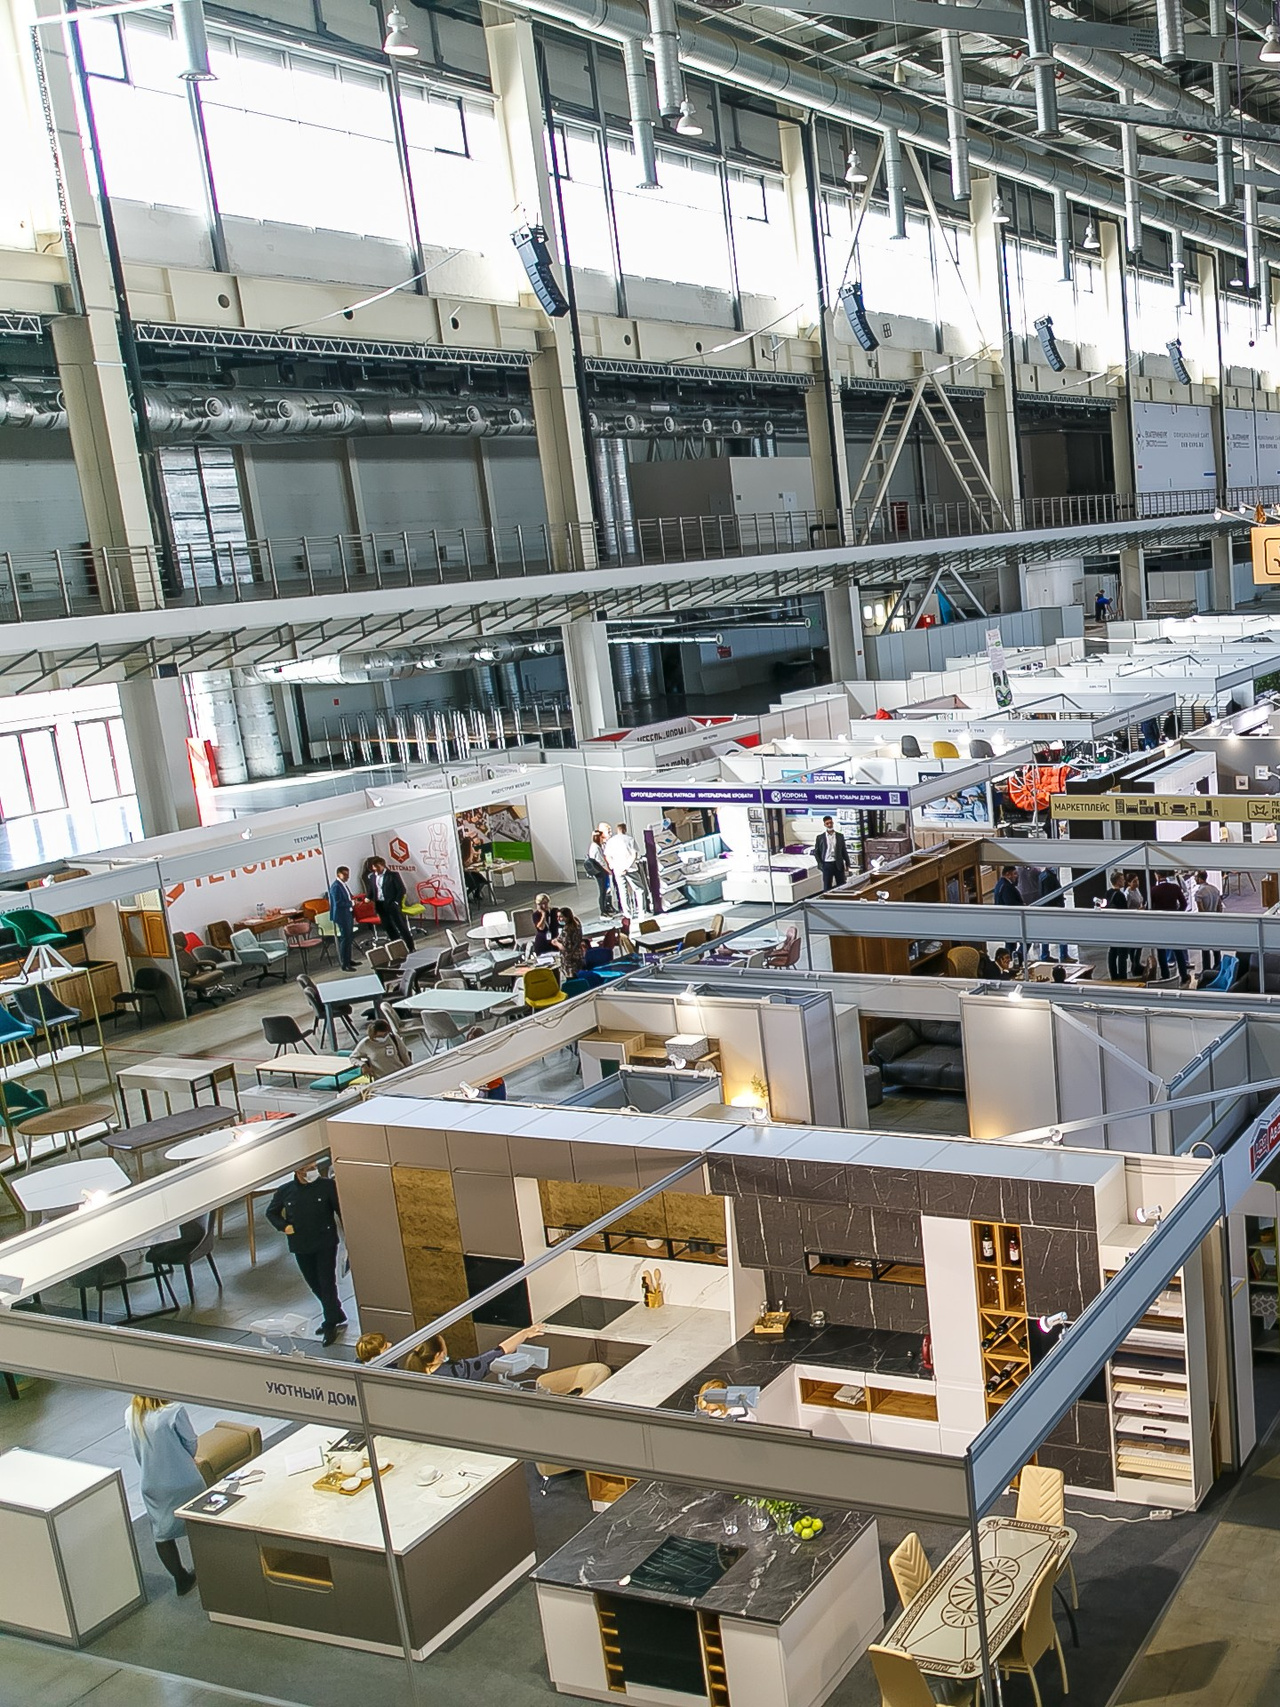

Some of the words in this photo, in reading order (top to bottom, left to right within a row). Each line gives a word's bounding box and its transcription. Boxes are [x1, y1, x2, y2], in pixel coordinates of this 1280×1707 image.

[491, 785, 515, 795] ИНДУСТРИЯ
[514, 781, 531, 789] МЕБЕЛИ
[1053, 801, 1110, 812] МАРКЕТПЛЕЙС
[293, 833, 319, 845] TETCHAIR
[265, 1380, 325, 1402] УЮТНЫЙ
[327, 1390, 358, 1407] ДОМ
